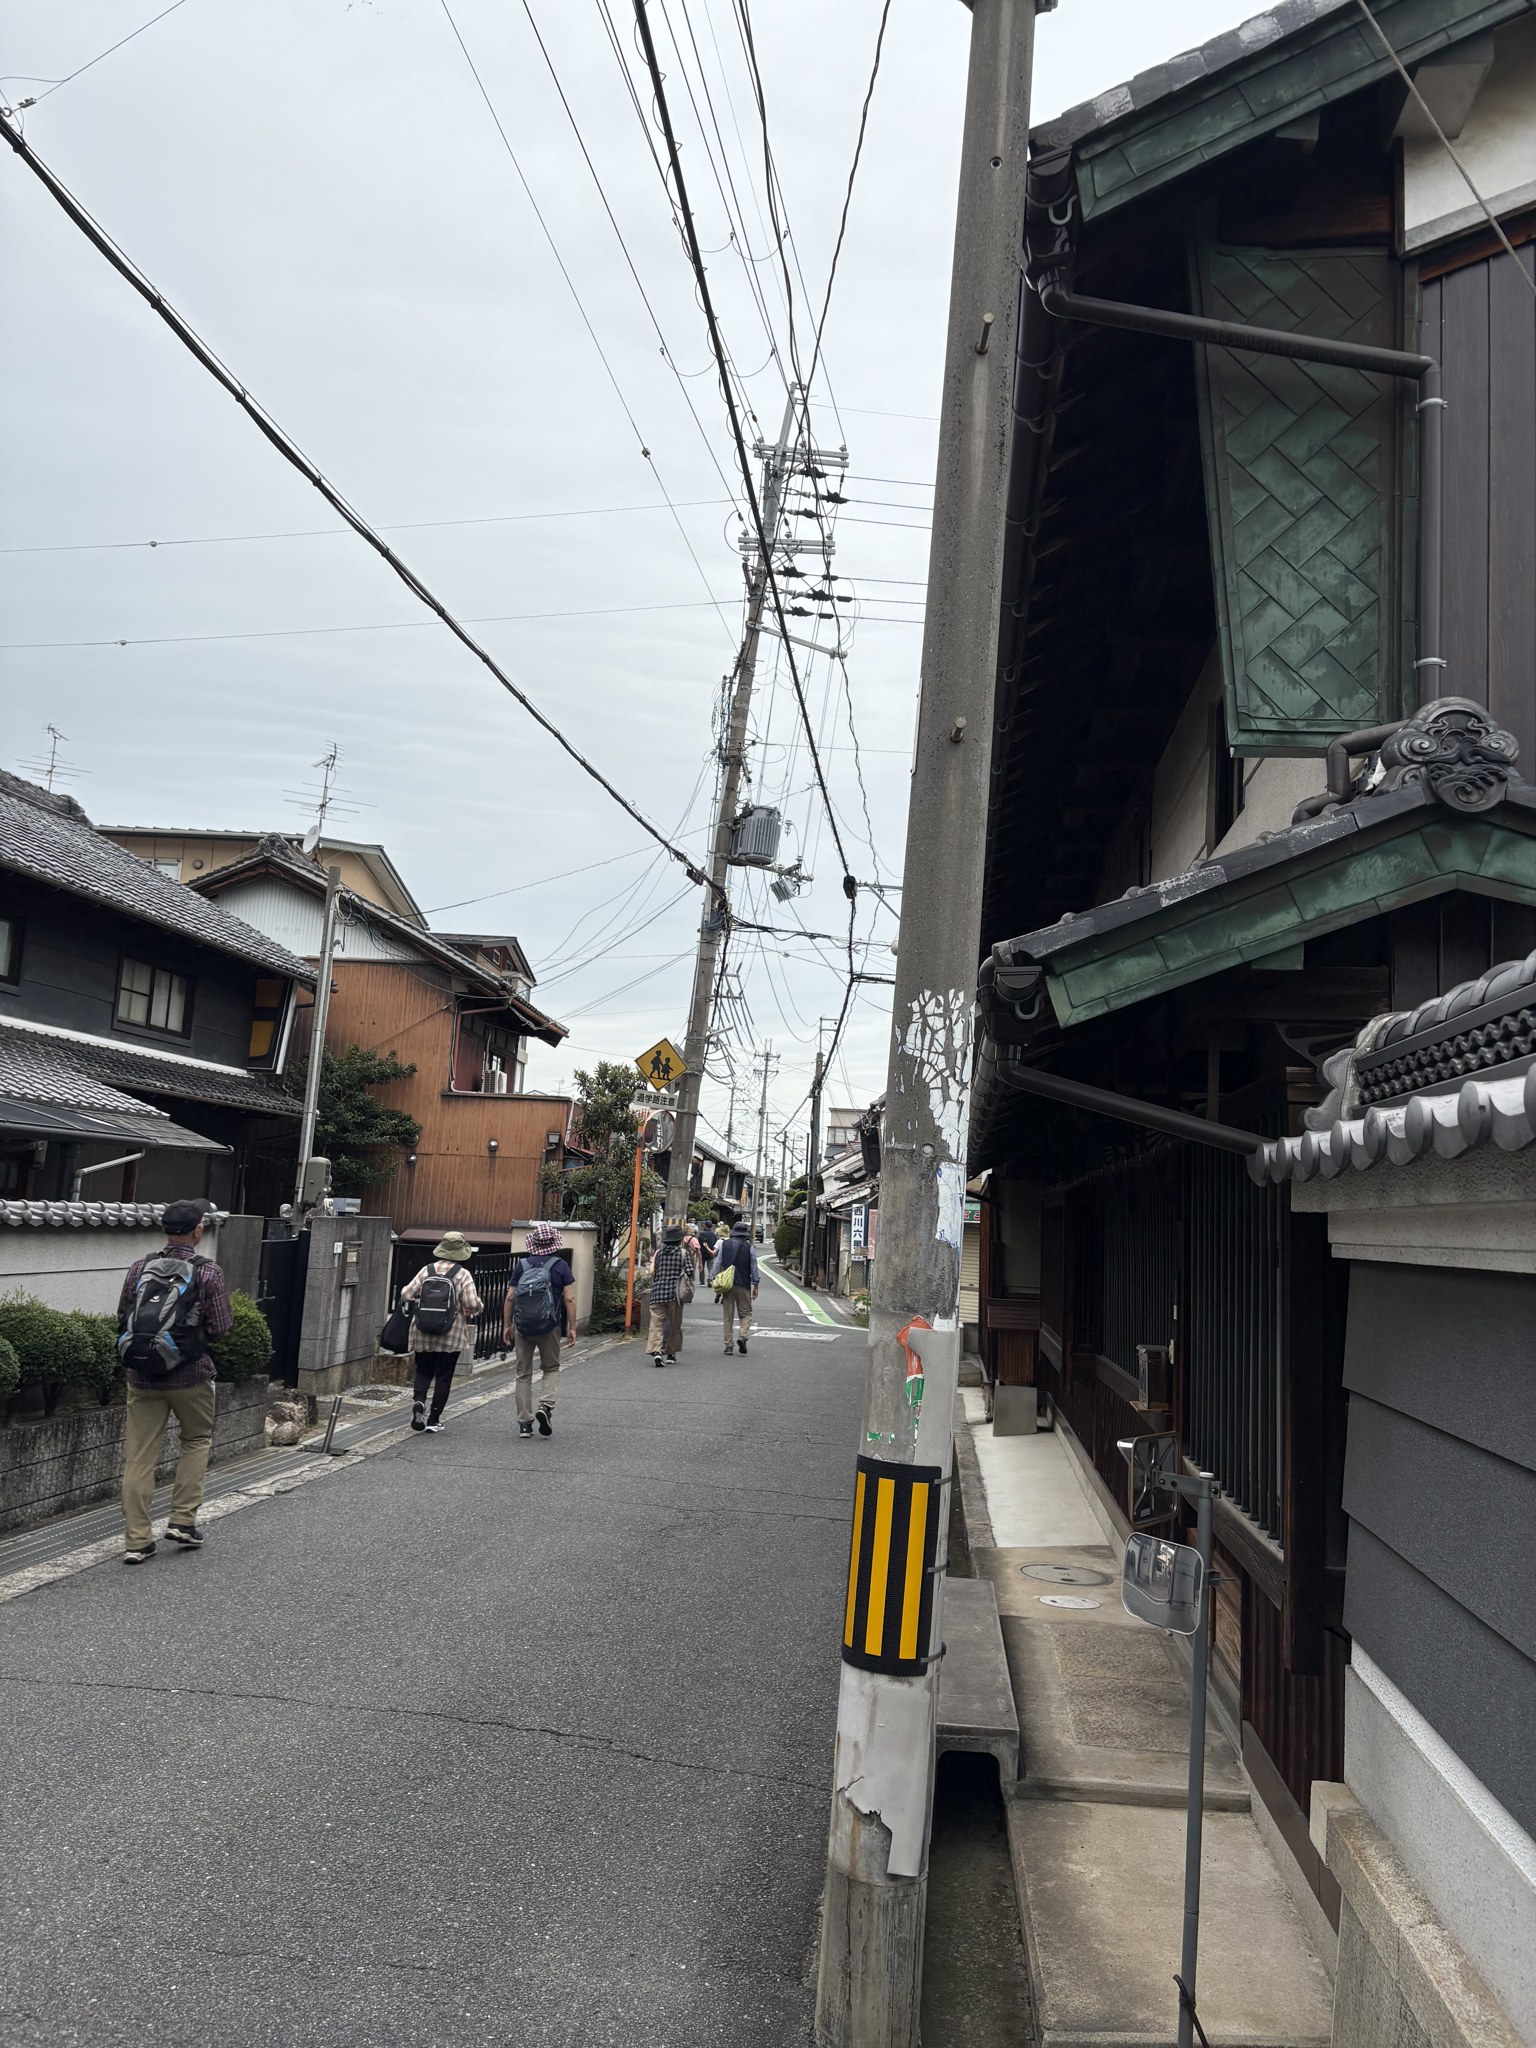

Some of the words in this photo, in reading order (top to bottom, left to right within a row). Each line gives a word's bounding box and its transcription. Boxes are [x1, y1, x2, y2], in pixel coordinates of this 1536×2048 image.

[636, 1092, 676, 1107] 通学路注意
